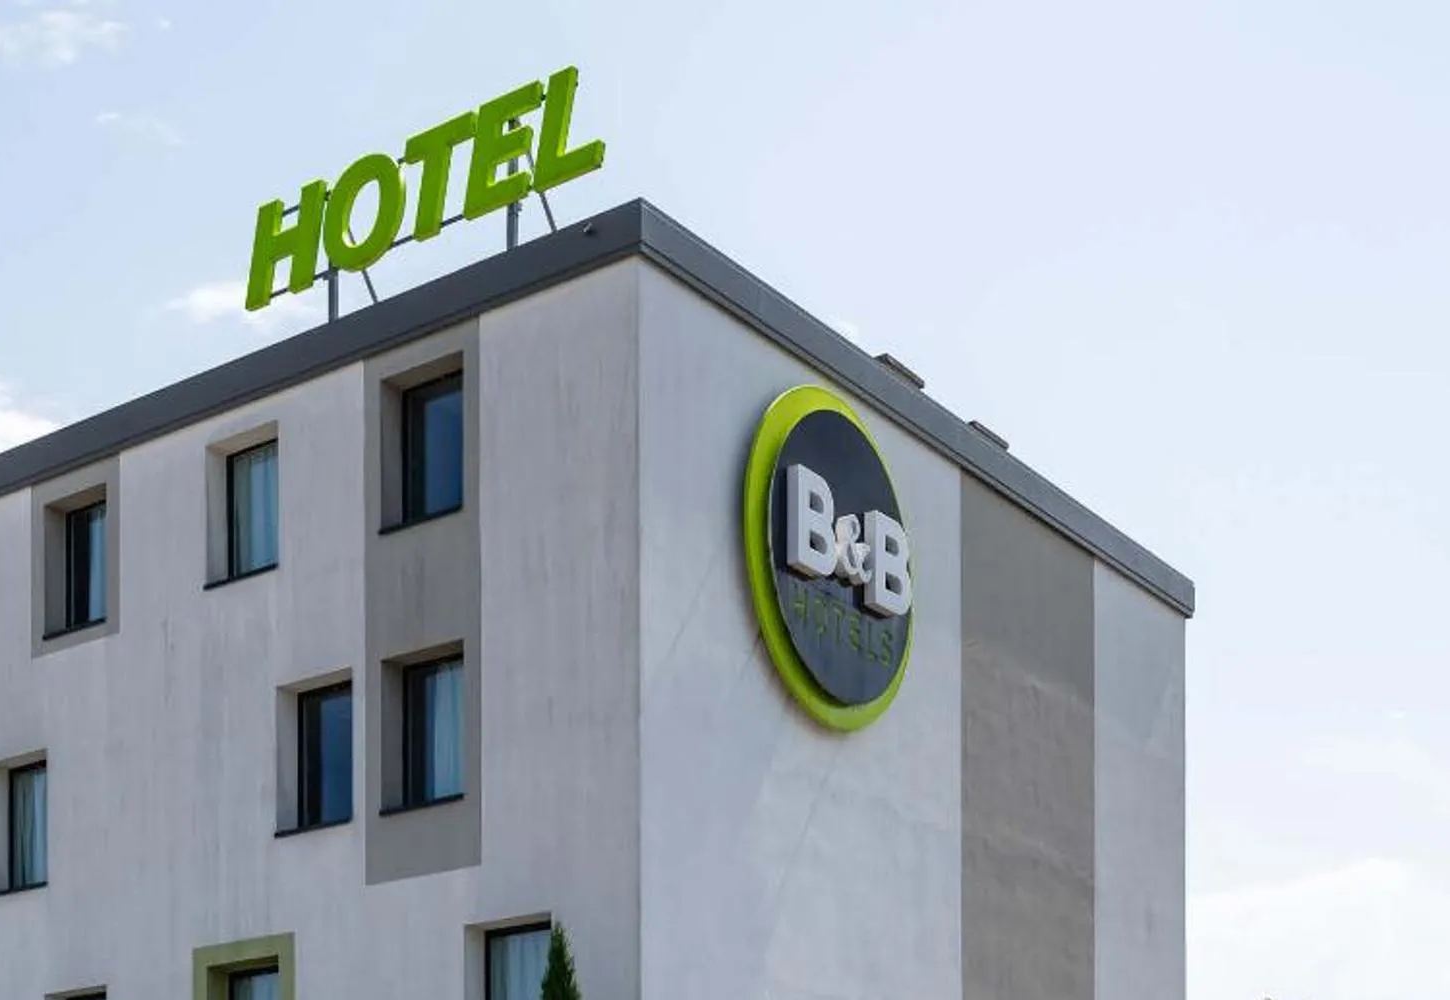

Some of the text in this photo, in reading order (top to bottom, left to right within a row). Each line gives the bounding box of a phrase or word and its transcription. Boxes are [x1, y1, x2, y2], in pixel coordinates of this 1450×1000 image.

[245, 65, 606, 312] HOTEL
[786, 463, 912, 616] B&B
[792, 586, 894, 667] HOTELS
